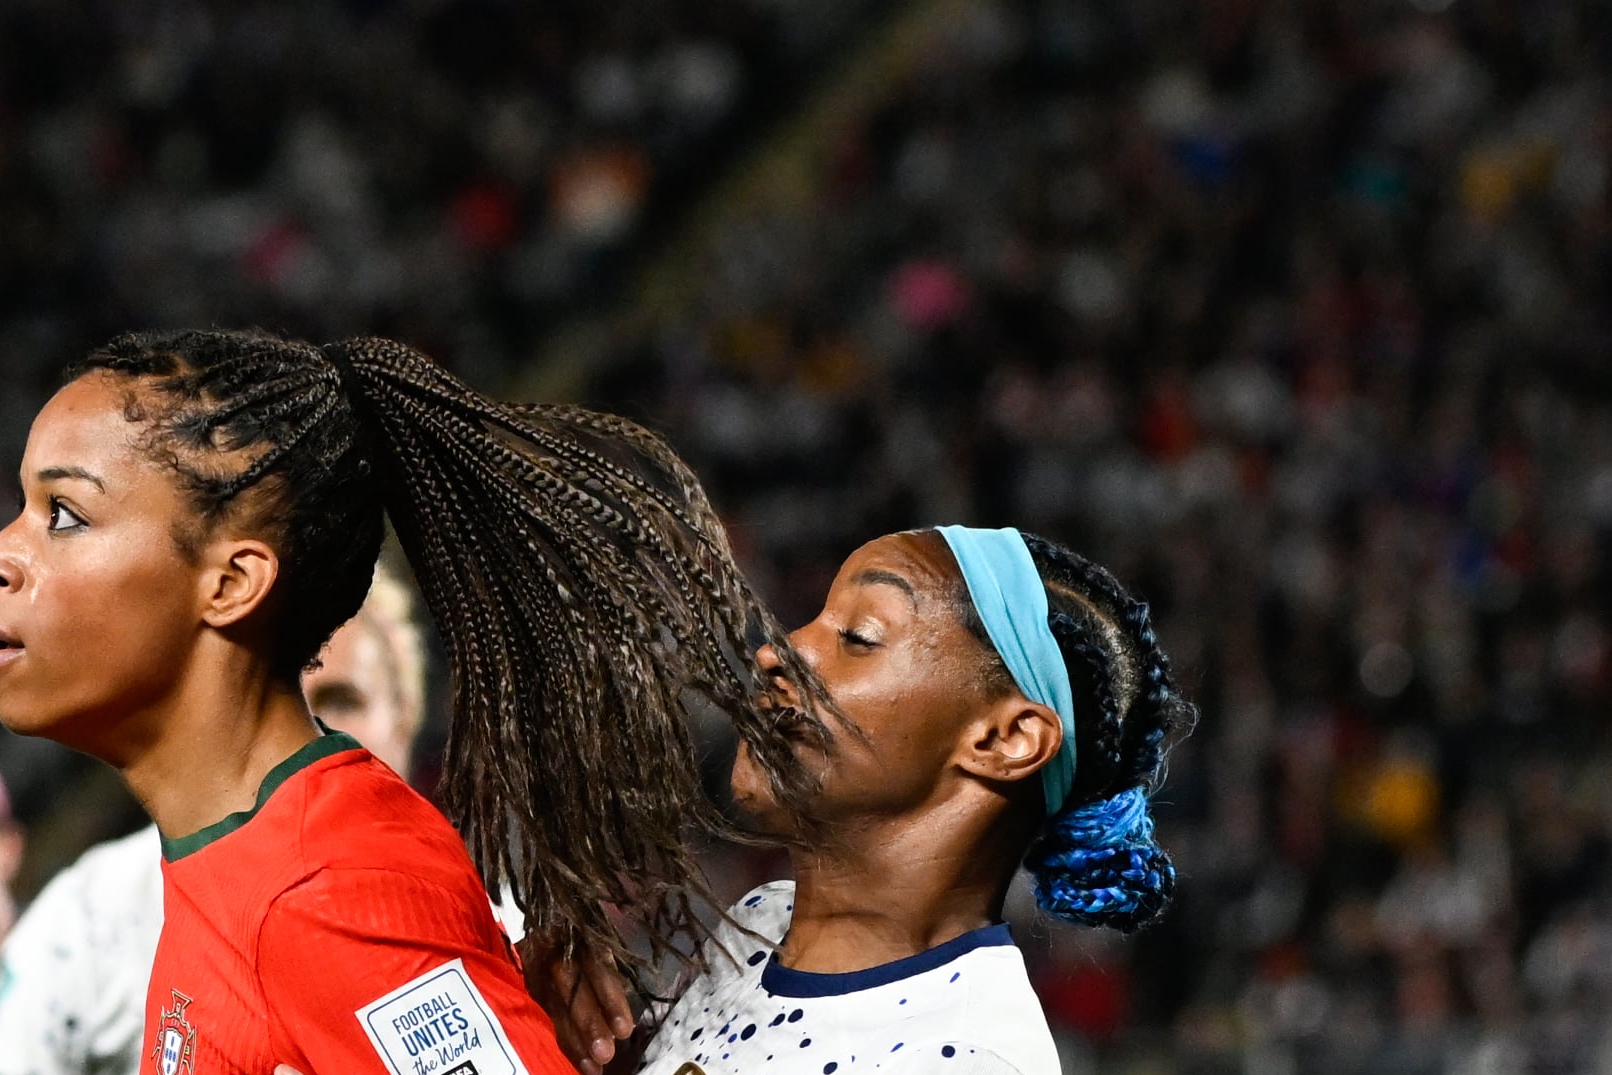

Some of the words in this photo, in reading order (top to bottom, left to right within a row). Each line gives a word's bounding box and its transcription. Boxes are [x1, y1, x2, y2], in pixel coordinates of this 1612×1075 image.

[392, 992, 457, 1034] FOOTBALL
[402, 1008, 468, 1056] UNITES
[435, 1027, 482, 1065] World
